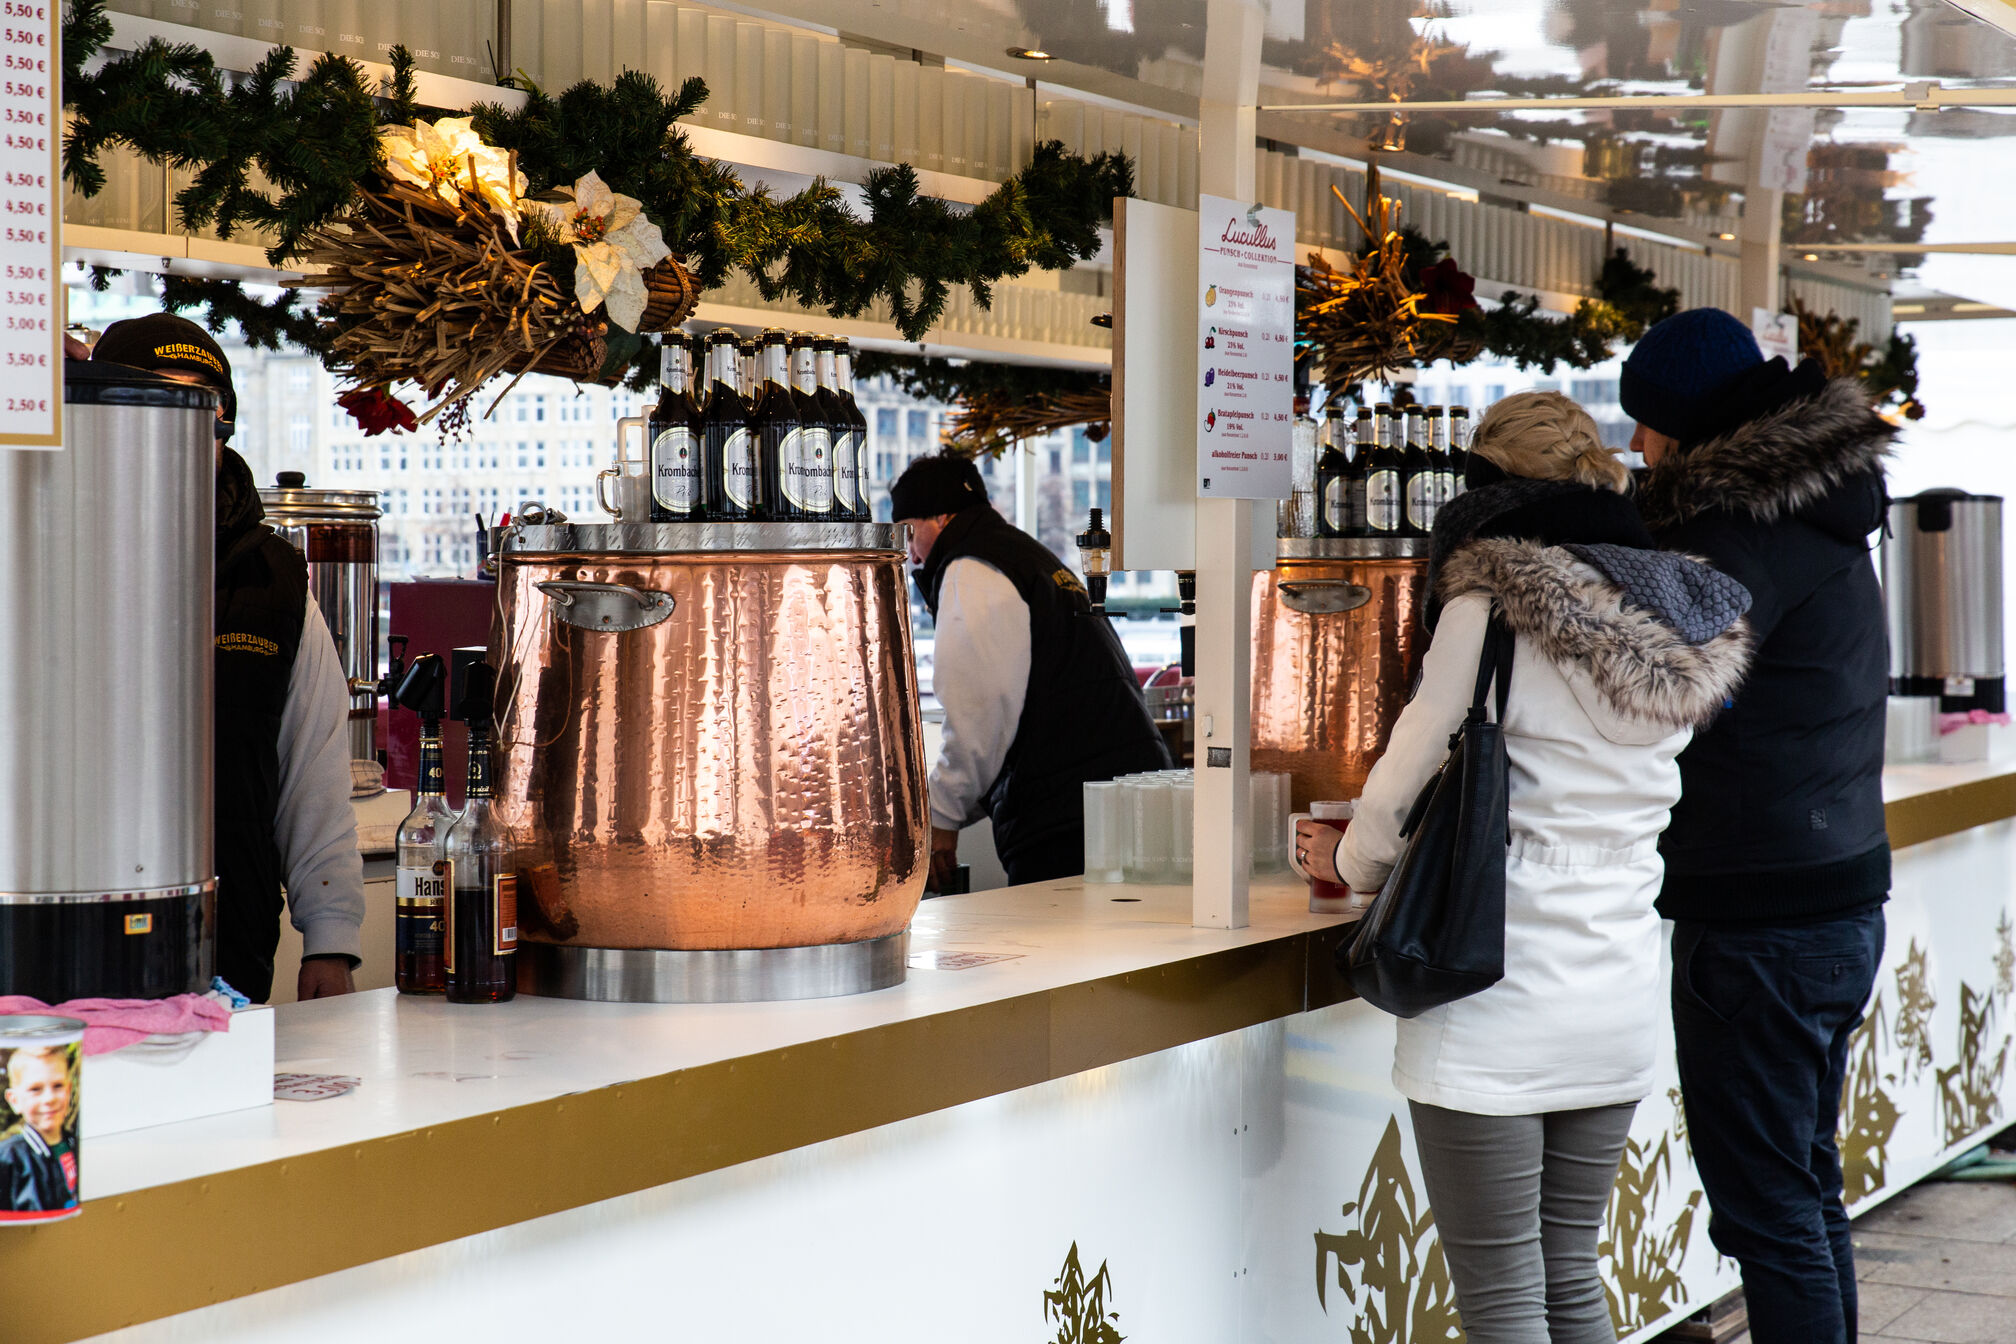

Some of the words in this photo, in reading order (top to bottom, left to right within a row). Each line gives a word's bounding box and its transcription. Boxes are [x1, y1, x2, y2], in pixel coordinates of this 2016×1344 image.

[4, 2, 33, 18] 5,50
[36, 7, 45, 20] €
[4, 28, 33, 44] 5,50
[36, 34, 45, 46] €
[340, 33, 354, 42] DIE
[415, 49, 429, 58] DIE
[5, 55, 33, 70] 5,50
[37, 60, 45, 72] €
[5, 81, 33, 97] 5,50
[37, 86, 45, 99] €
[5, 108, 33, 124] 3,50
[37, 113, 45, 125] €
[5, 133, 33, 149] 4,50
[37, 138, 45, 151] €
[5, 171, 33, 187] 4,50
[37, 175, 45, 188] €
[5, 199, 34, 215] 4,50
[38, 203, 45, 216] €
[38, 231, 46, 244] €
[1221, 217, 1276, 250] Lucullus
[38, 268, 46, 280] €
[38, 293, 46, 306] €
[38, 319, 46, 331] €
[1218, 327, 1248, 338] Kirschpunsch
[38, 354, 46, 367] €
[1218, 368, 1258, 380] Heidelbeerpunsch
[6, 398, 35, 412] 2,50
[39, 400, 46, 412] €
[1211, 449, 1241, 459] alkoholfreier
[1241, 451, 1257, 460] Punsch
[428, 767, 443, 778] 40
[429, 920, 446, 932] 40
